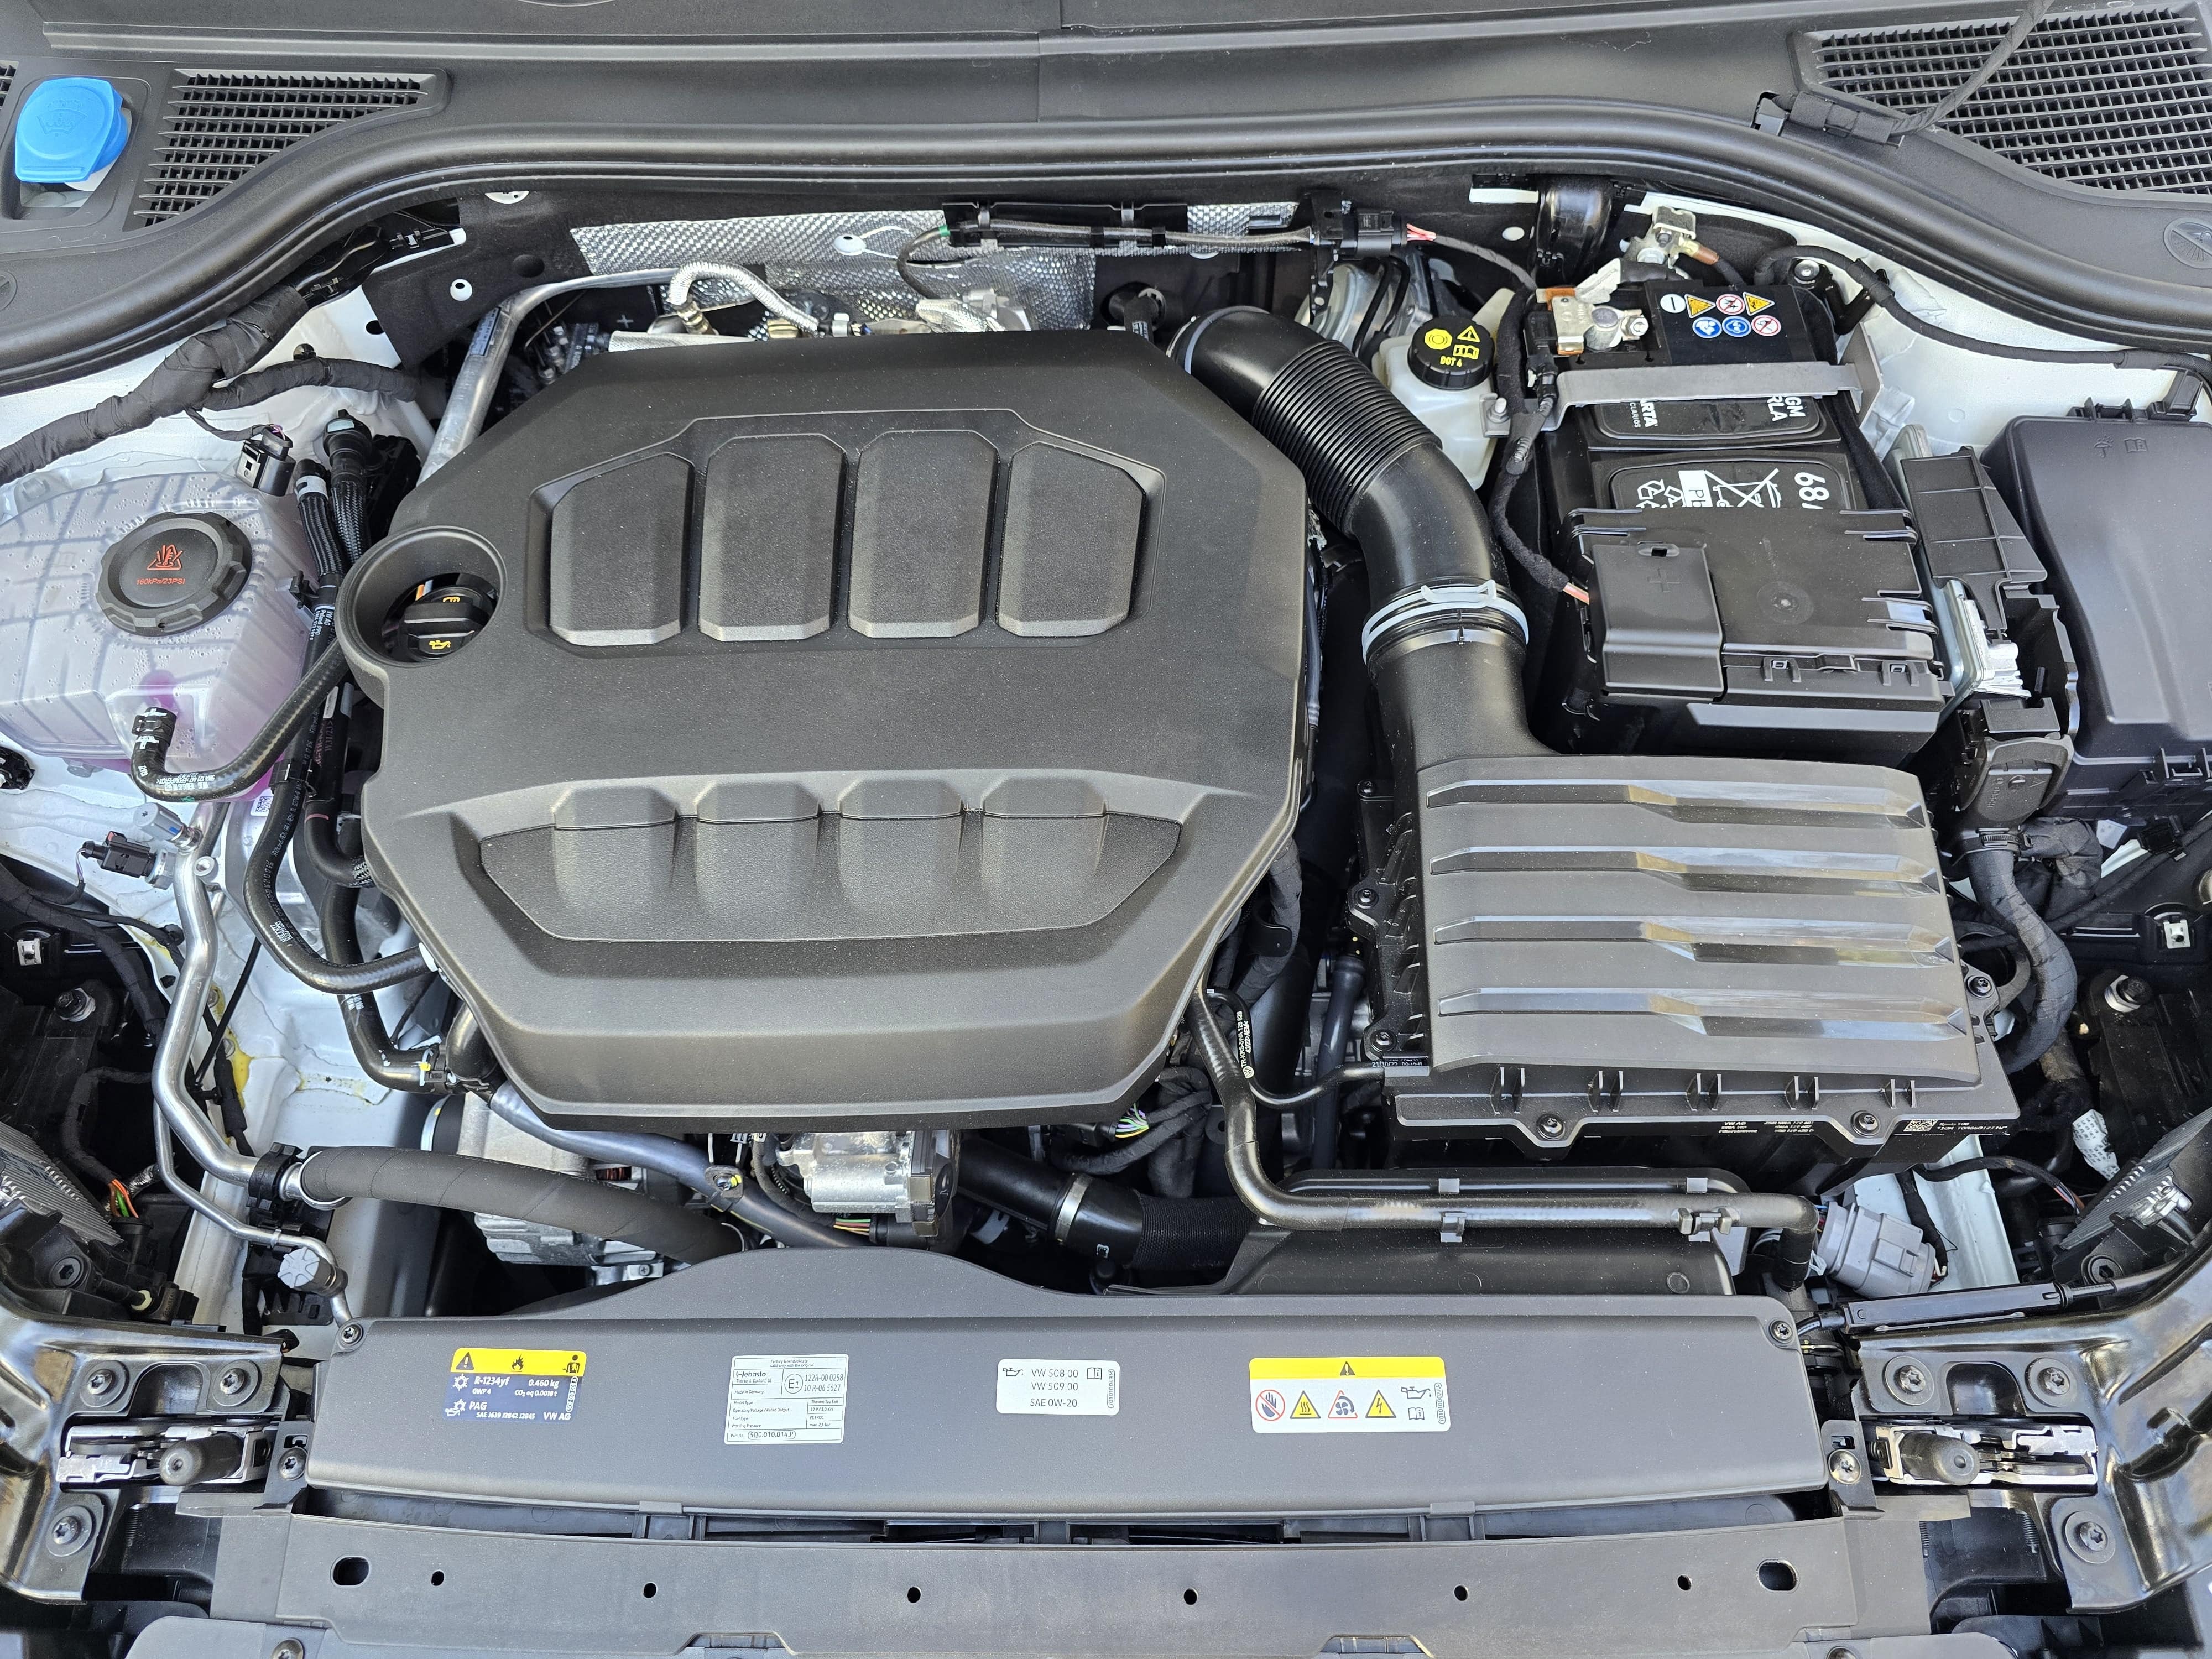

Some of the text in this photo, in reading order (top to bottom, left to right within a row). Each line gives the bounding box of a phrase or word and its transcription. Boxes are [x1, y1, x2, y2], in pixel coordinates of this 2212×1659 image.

[1440, 356, 1462, 367] DOT 4
[1767, 395, 1788, 421] RLA
[1785, 397, 1806, 417] GM
[1629, 402, 1641, 428] CLARIOS
[1640, 400, 1658, 427] RTA
[326, 611, 333, 619] VW
[1031, 1369, 1046, 1377] VW
[474, 1376, 510, 1386] R-1234yf
[550, 1379, 559, 1389] kg
[788, 1379, 799, 1389] E1
[469, 1401, 487, 1410] PAG
[1048, 1399, 1078, 1407] 0W-20
